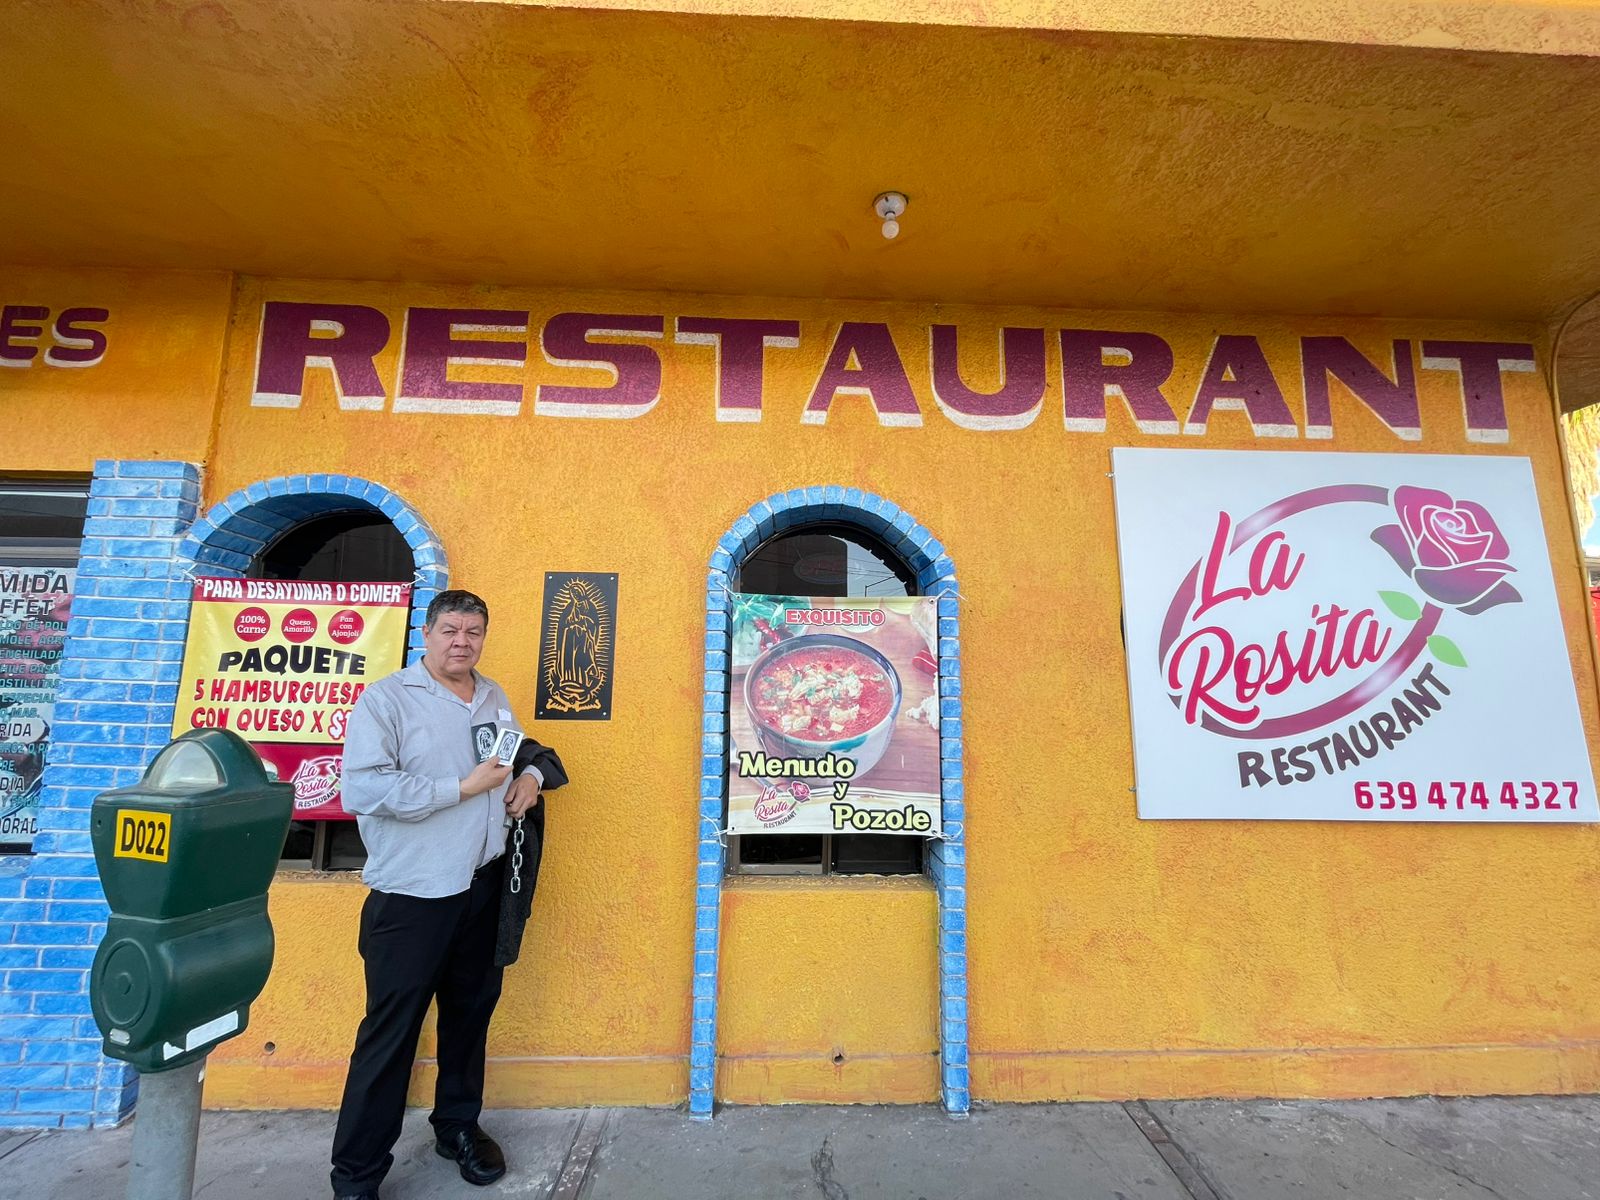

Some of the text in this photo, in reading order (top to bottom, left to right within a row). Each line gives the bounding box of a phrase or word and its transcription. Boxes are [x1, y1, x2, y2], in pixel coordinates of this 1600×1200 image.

[0, 305, 109, 368] ES
[251, 301, 1537, 443] RESTAURANT
[1192, 510, 1305, 622] La
[203, 579, 401, 603] PARA DESAYUNAR O COMER
[236, 625, 267, 634] Carne
[240, 615, 266, 624] 100%
[785, 609, 886, 626] EXQUISITO
[218, 645, 366, 676] PAQUETE
[1167, 604, 1392, 725] Rosita
[194, 679, 365, 705] 5 HAMBURGUESA
[190, 707, 229, 730] CON
[236, 708, 305, 731] QUESO
[311, 710, 325, 733] X
[1237, 662, 1452, 789] RESTAURANT
[739, 753, 855, 779] Menudo
[298, 789, 336, 808] RESTAURANT
[833, 782, 847, 800] y
[1353, 781, 1579, 810] 639 474 4327
[755, 801, 789, 820] Rosita
[764, 810, 797, 828] RESTAURANT
[832, 804, 931, 832] Pozole
[0, 817, 38, 834] ORAD
[121, 817, 165, 856] D022
